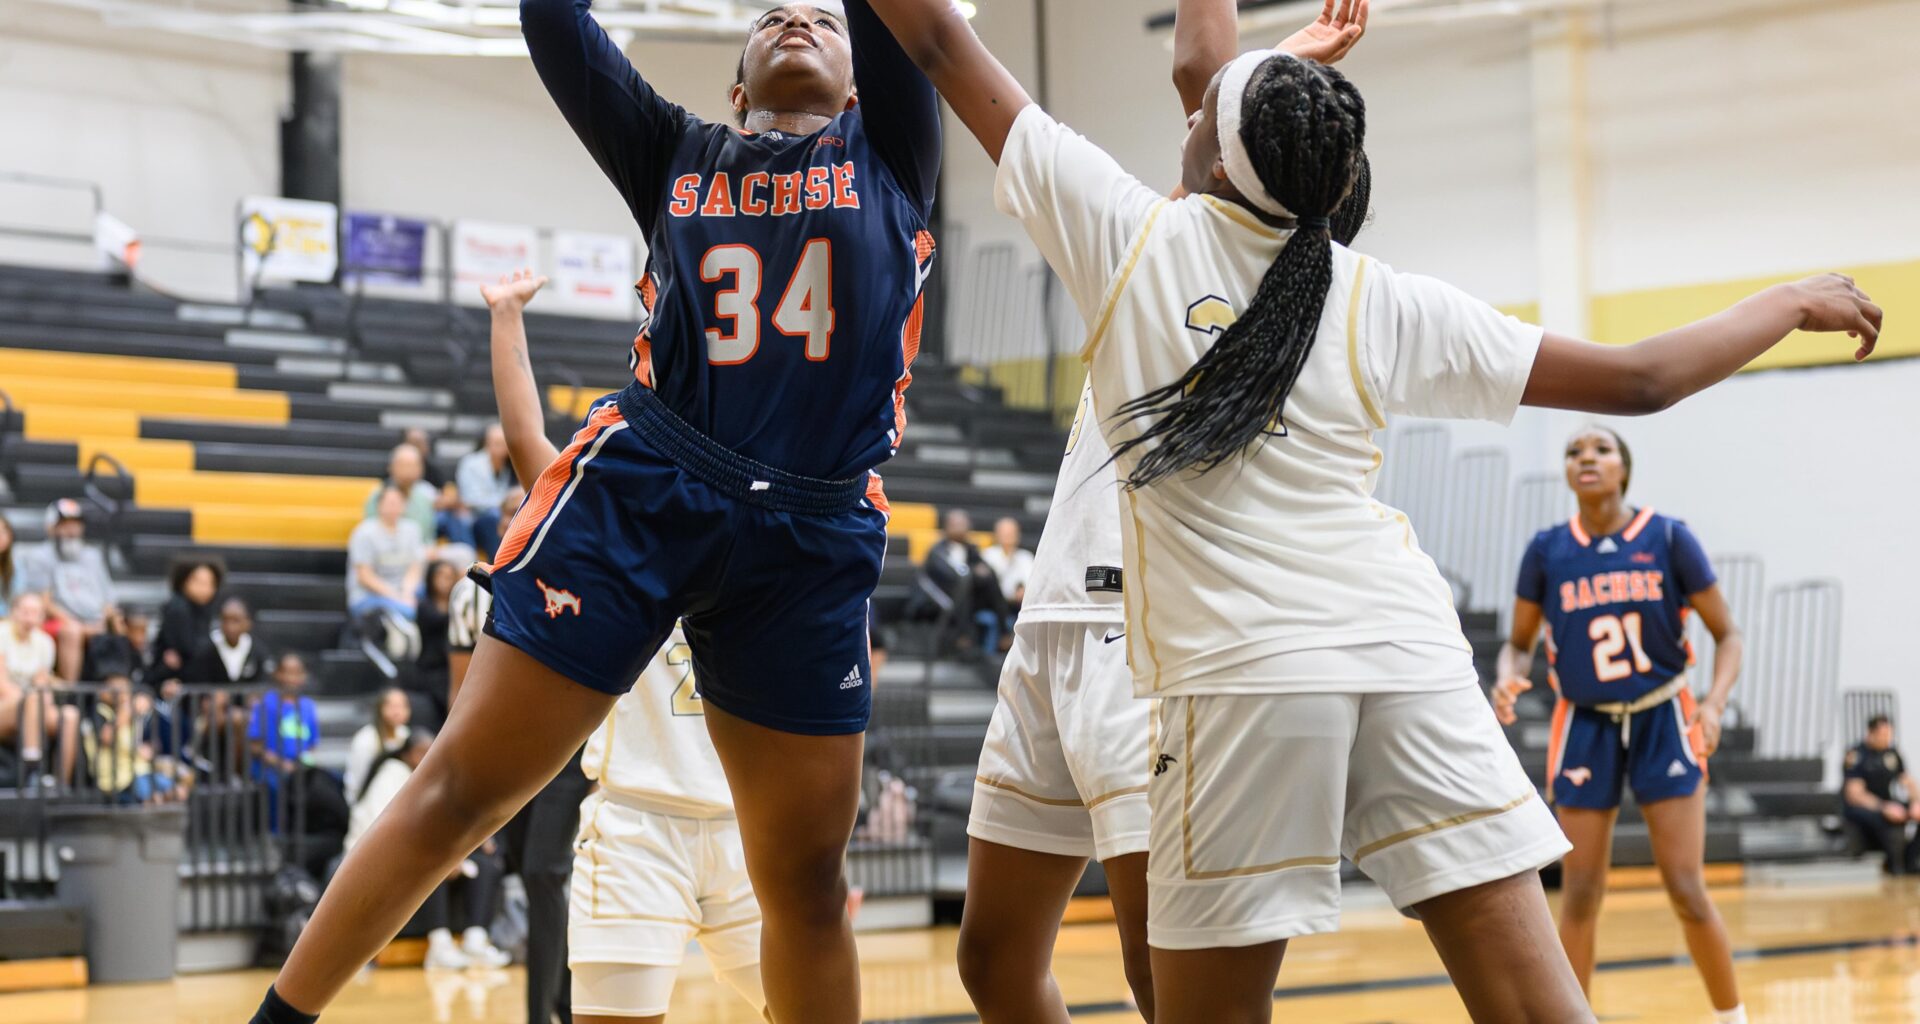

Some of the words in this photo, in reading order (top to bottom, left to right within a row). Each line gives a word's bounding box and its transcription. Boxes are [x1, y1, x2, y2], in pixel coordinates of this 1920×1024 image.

[669, 161, 861, 217] SACHSE
[700, 237, 836, 366] 34
[1111, 573, 1117, 584] L
[1560, 570, 1664, 613] SACHSE
[1588, 611, 1652, 682] 21
[839, 678, 863, 690] adidas
